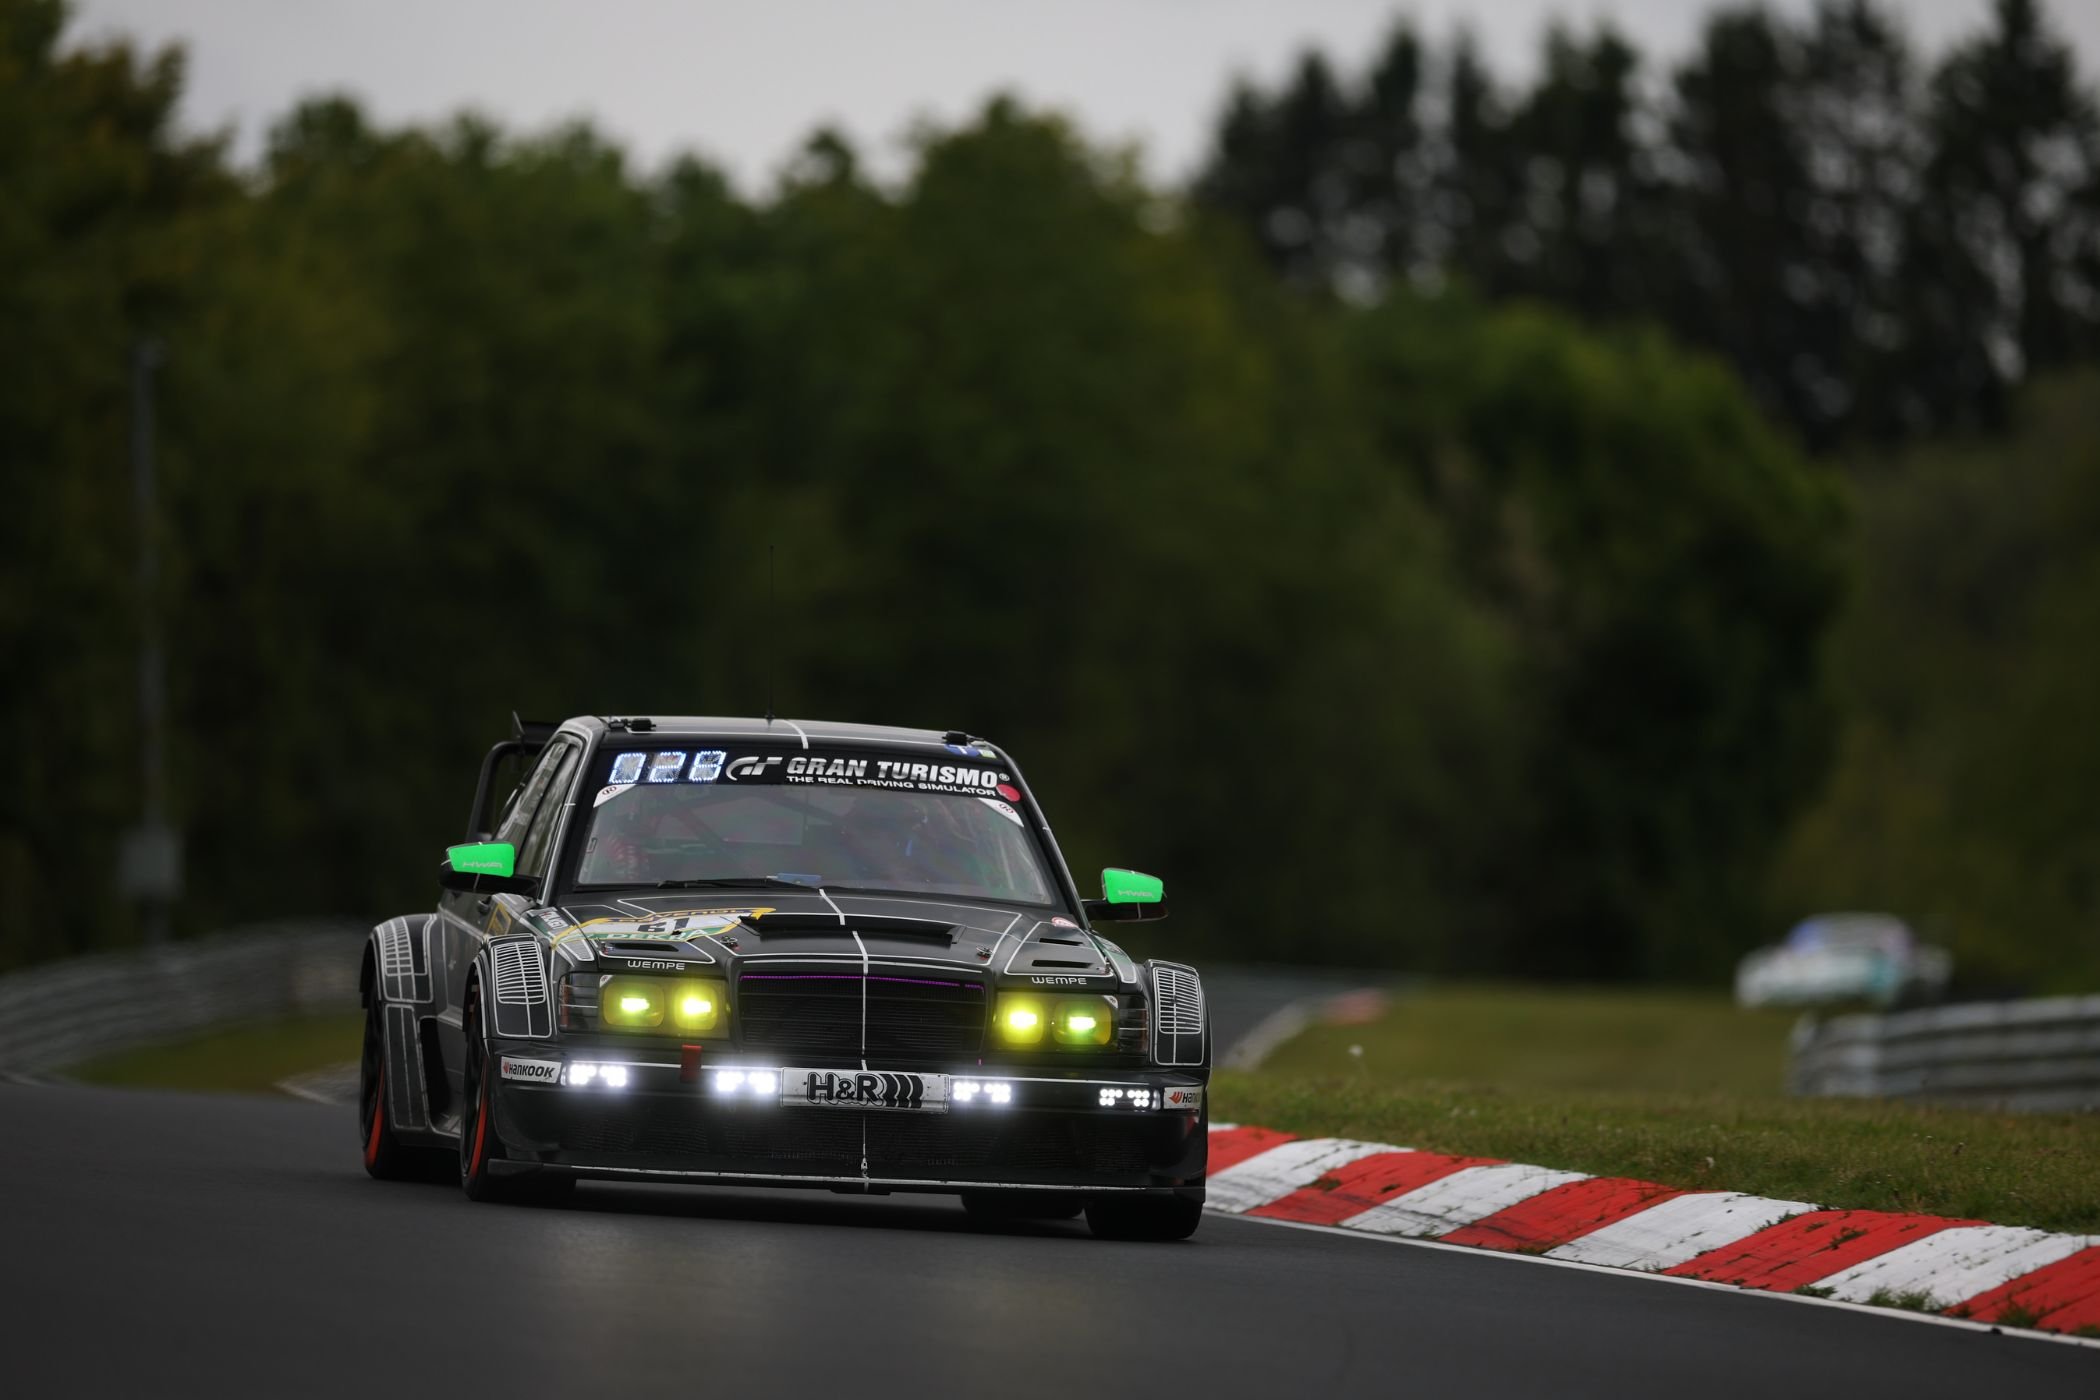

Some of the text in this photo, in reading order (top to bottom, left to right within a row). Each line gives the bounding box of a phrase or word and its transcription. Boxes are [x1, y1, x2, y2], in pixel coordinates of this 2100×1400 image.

[787, 757, 867, 777] GRAN
[787, 775, 996, 797] THE REAL DRIVING SIMULATOR
[628, 960, 686, 970] WEMPE
[1032, 977, 1088, 985] WEMPE
